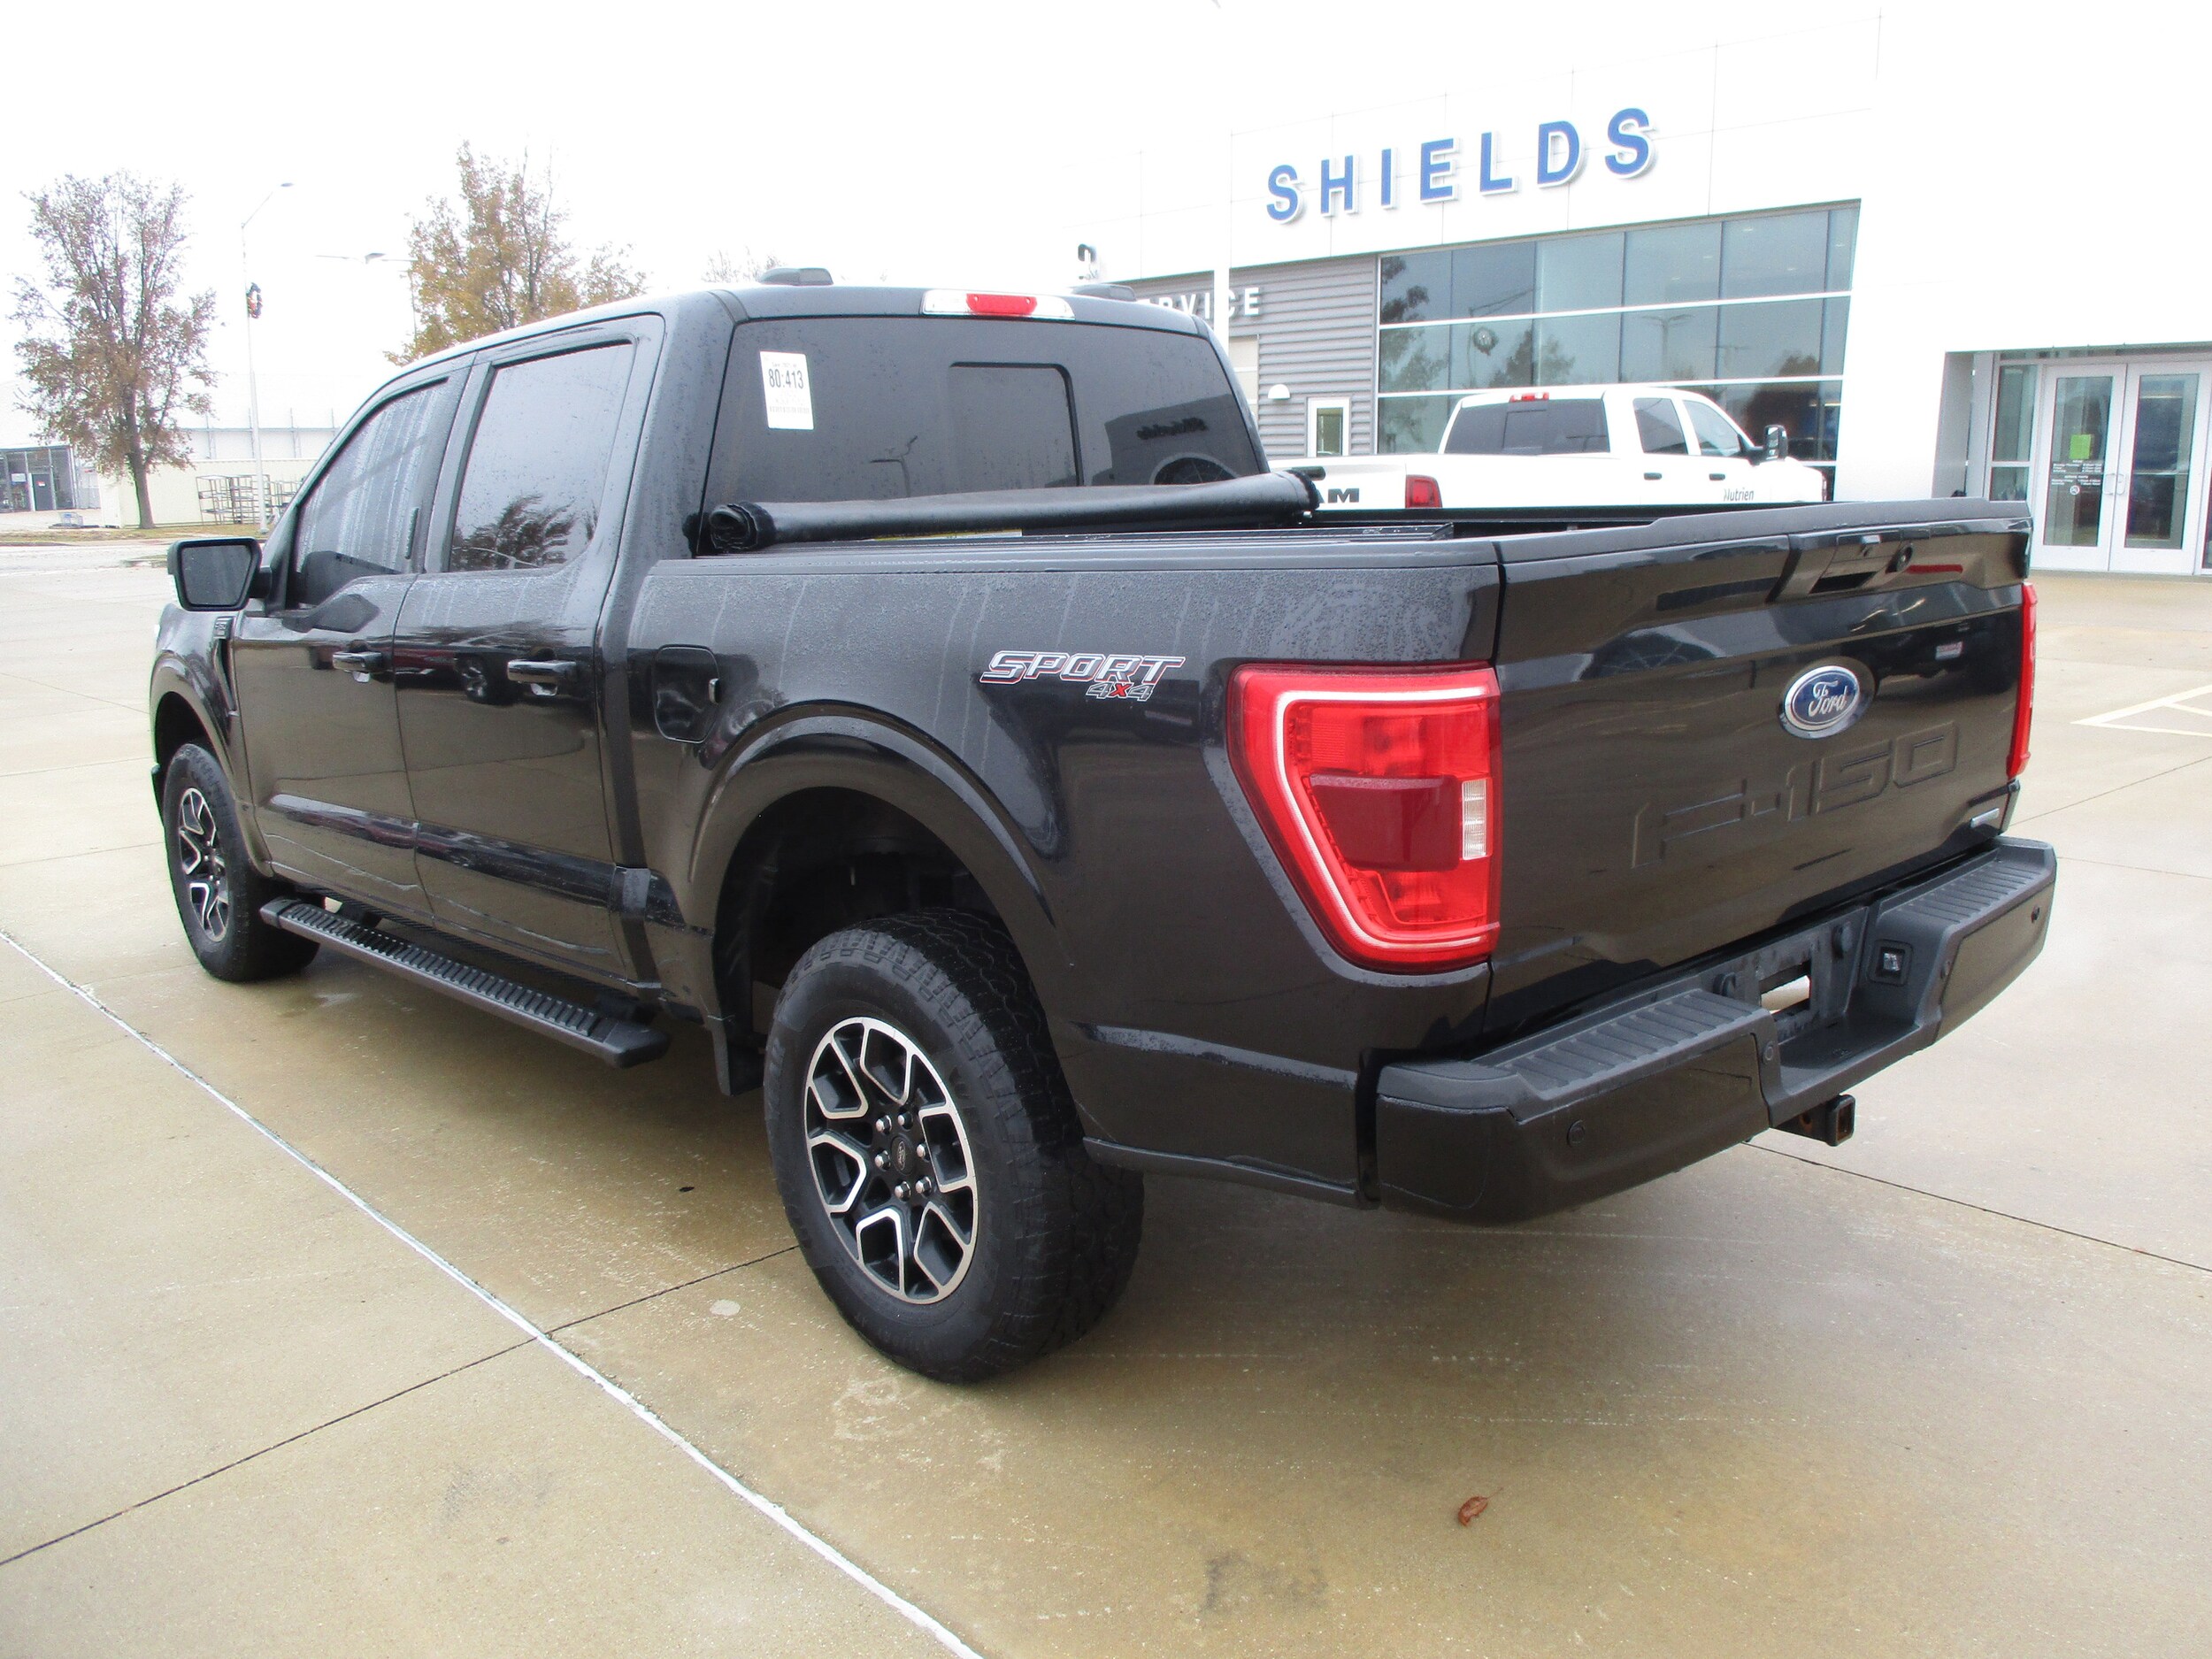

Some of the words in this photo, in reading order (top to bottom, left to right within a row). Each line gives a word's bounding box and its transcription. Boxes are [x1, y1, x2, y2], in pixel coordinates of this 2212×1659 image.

[1266, 107, 1653, 223] SHIELDS
[979, 650, 1187, 685] SPORT
[1808, 680, 1848, 718] Ford
[1632, 720, 1960, 869] F-150
